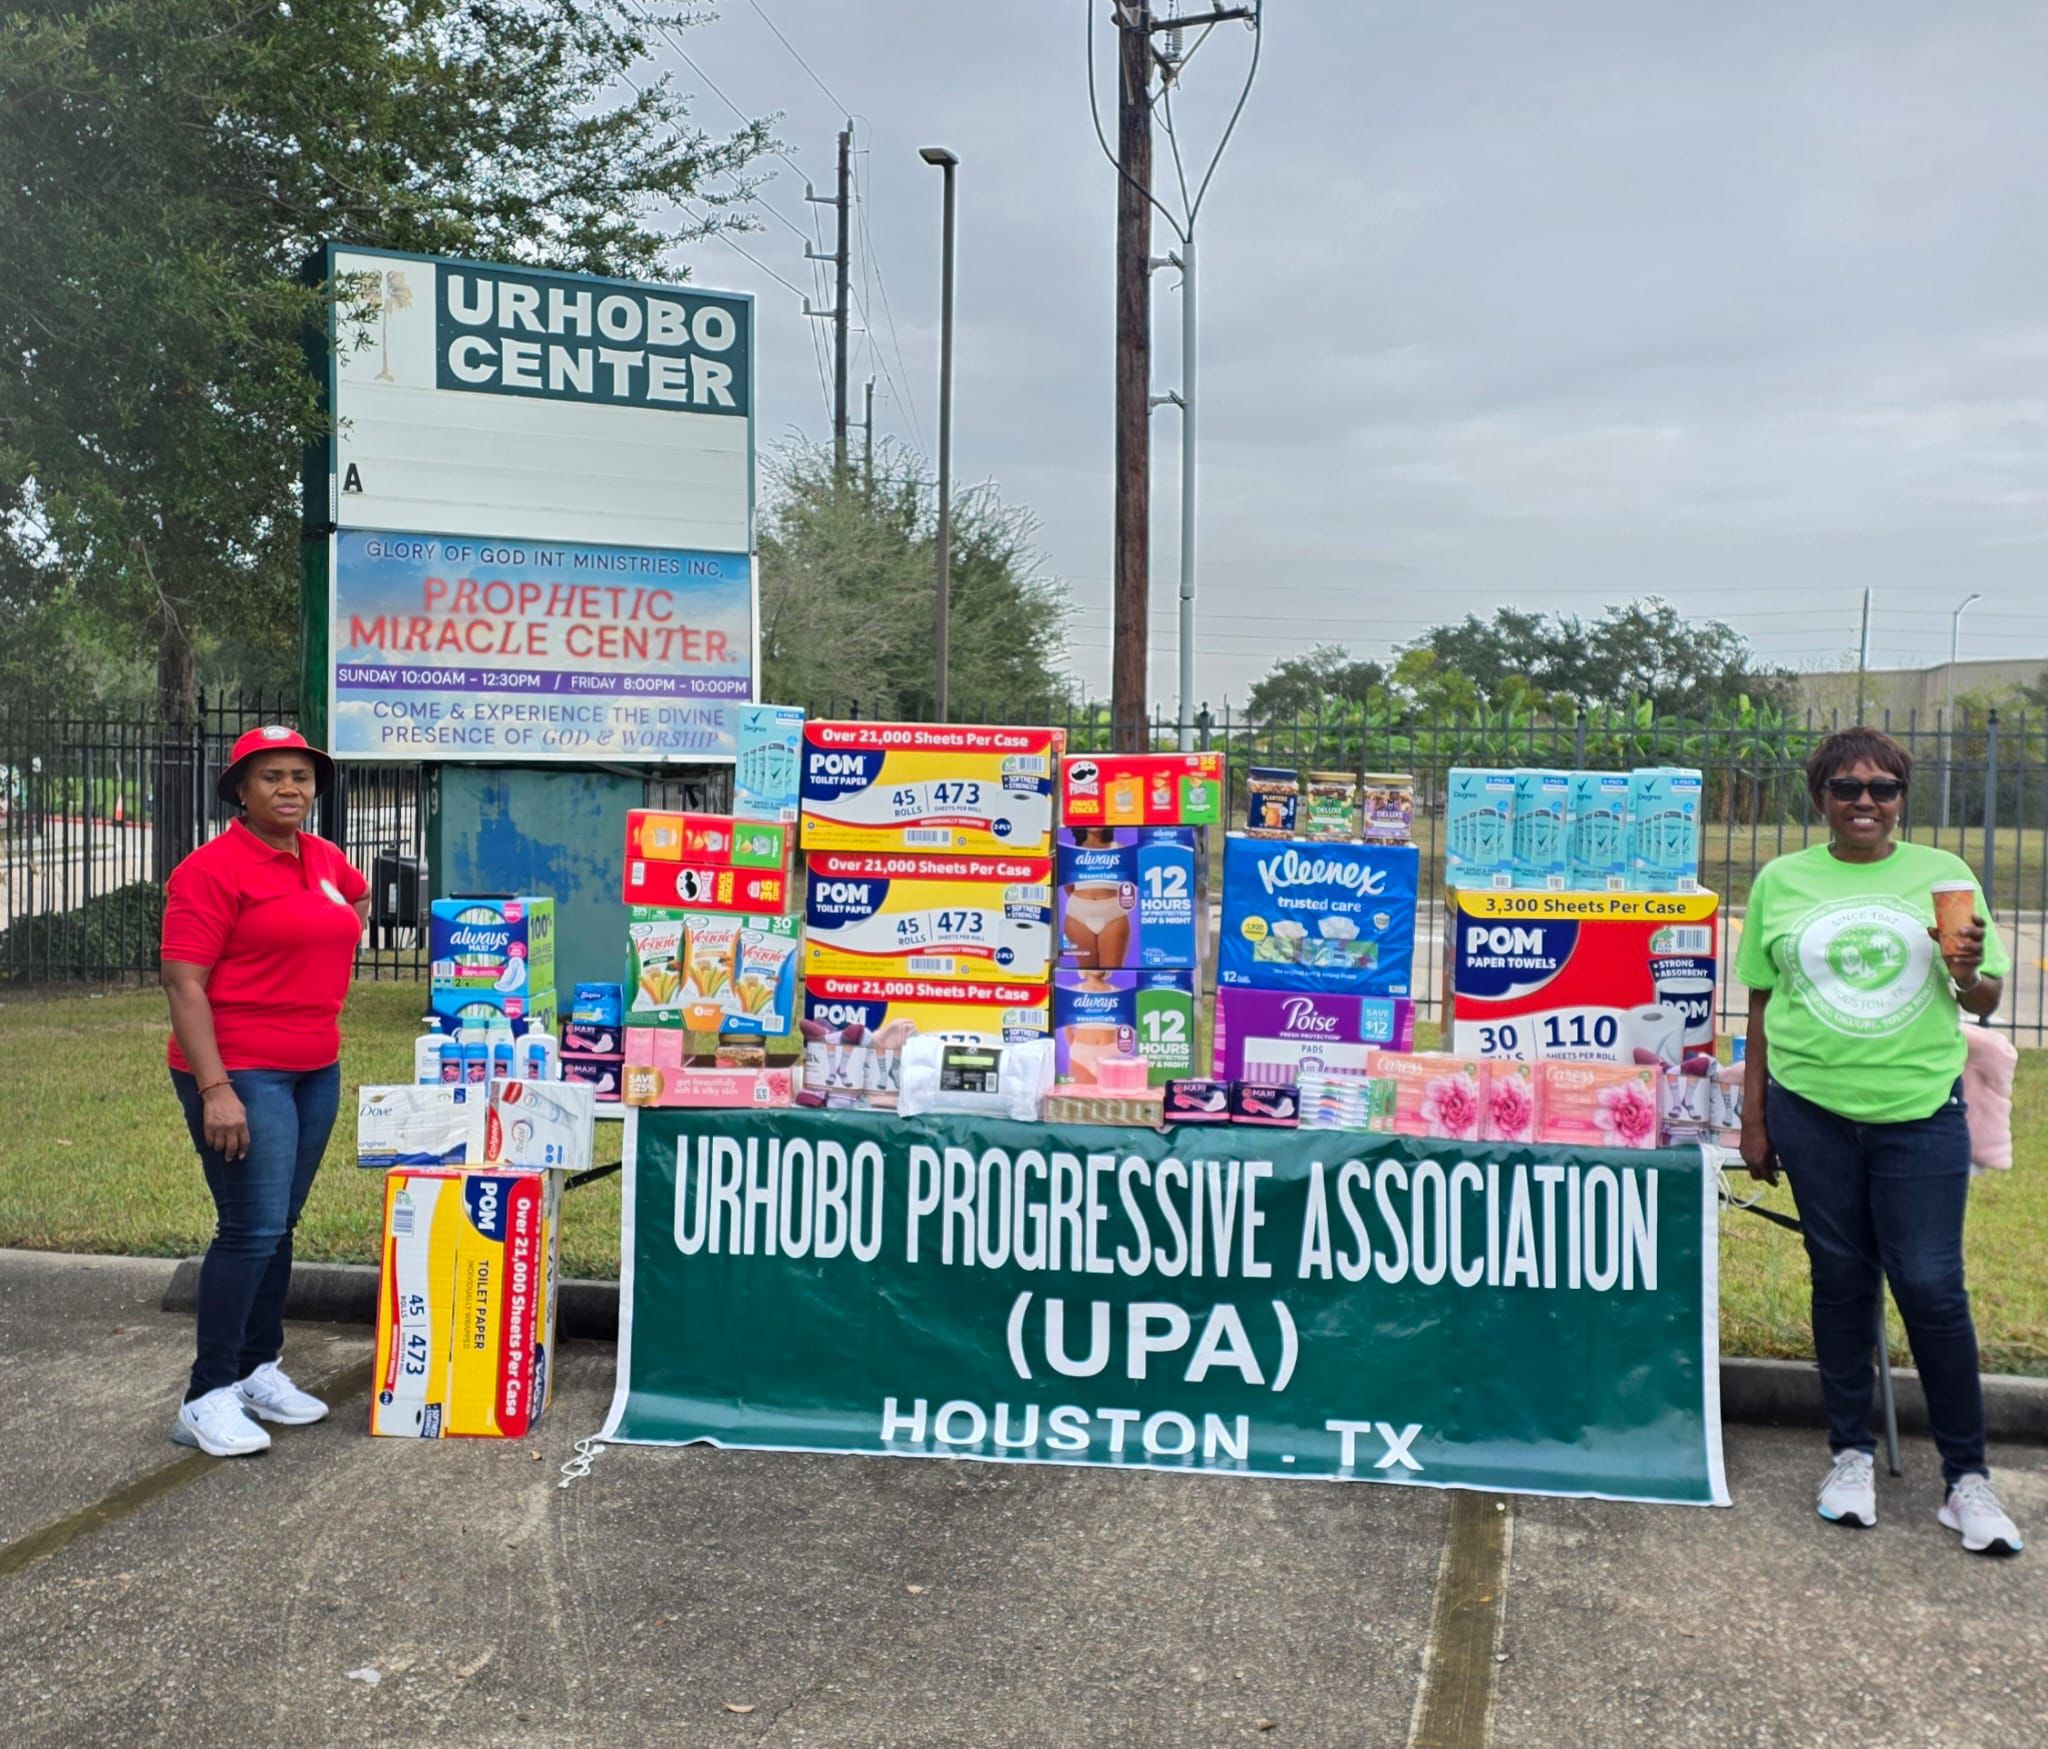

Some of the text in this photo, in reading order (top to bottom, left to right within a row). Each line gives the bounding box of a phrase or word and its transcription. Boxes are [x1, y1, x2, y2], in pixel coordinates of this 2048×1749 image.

[447, 273, 737, 352] URHOBO
[447, 334, 736, 407] CENTER
[342, 462, 364, 493] A
[367, 541, 435, 560] GLORY
[444, 545, 472, 561] OF
[480, 548, 525, 565] GOD
[534, 551, 566, 566] INT
[574, 554, 680, 574] MINISTRIES
[423, 577, 674, 622] PROPHETIC
[350, 613, 548, 656] MIRACLE
[338, 669, 398, 684] SUNDAY
[401, 670, 465, 685] 10:00AM
[482, 673, 541, 687] 12:30PM
[553, 673, 561, 690] /
[571, 676, 616, 690] FRIDAY
[623, 677, 675, 692] 8:00PM
[690, 679, 747, 693] 10:00PM
[373, 700, 725, 726] COME & EXPERIENCE THE DIVINE
[382, 726, 718, 749] PRESENCE OF GOD & WORSHIP
[743, 724, 767, 734] Degree
[822, 728, 1029, 747] Over 21,000 Sheets Per Case
[809, 753, 864, 775] POM
[810, 776, 867, 785] TOILET PAPER
[892, 783, 980, 807] 45 473
[1454, 791, 1477, 799] Degree
[1638, 794, 1662, 802] Degree
[894, 807, 923, 817] ROLLS
[828, 857, 1031, 876] Over 21,000 Sheets Per Case
[1075, 851, 1120, 869] always
[1144, 865, 1188, 898] 12
[1257, 850, 1387, 897] Kleenex
[816, 883, 868, 904] POM
[816, 904, 872, 914] TOILET PAPER
[1141, 899, 1191, 910] HOURS
[1277, 897, 1362, 912] trusted care
[1486, 898, 1687, 915] 3,300 Sheets Per Case
[772, 917, 792, 929] 30
[896, 911, 983, 935] 45 473
[1141, 917, 1191, 925] DAY NIGHT
[450, 926, 510, 952] always
[635, 937, 679, 952] Veggie
[691, 930, 735, 945] Veggie
[898, 934, 926, 945] ROLLS
[1466, 927, 1543, 955] POM
[742, 943, 787, 962] Veggie
[1467, 957, 1556, 969] PAPER TOWELS
[1660, 960, 1694, 969] STRONG
[1222, 970, 1237, 982] 12
[1661, 969, 1708, 977] ABSORBENT
[825, 979, 1029, 1001] Over 21,000 Sheets Per Case
[1073, 993, 1119, 1012] always
[814, 1004, 867, 1025] POM
[1281, 997, 1338, 1032] Poise
[1367, 1009, 1389, 1017] SAVE
[574, 1025, 596, 1034] MAXI
[1142, 1010, 1186, 1042] 12
[1366, 1021, 1388, 1035] $12
[1479, 1015, 1618, 1053] 30 110
[1139, 1043, 1190, 1055] HOURS
[1301, 1044, 1323, 1054] PADS
[1596, 1053, 1616, 1061] ROLL
[574, 1065, 597, 1074] MAXI
[628, 1073, 656, 1084] SAVE
[676, 1080, 691, 1088] get
[1183, 1084, 1206, 1092] MAXI
[1252, 1090, 1275, 1098] MAXI
[359, 1103, 393, 1117] Dove
[488, 1118, 499, 1158] Colgate
[477, 1181, 498, 1233] POM
[673, 1134, 1659, 1291] URHOBO PROGRESSIVE ASSOCIATION
[462, 1260, 474, 1349] INDIVIDUALLY WRAPPED
[473, 1260, 490, 1350] TOILET PAPER
[505, 1197, 531, 1417] Over 21,000 Sheets Per Case
[405, 1294, 427, 1375] 45 473
[1006, 1291, 1299, 1392] (UPA)
[880, 1397, 1249, 1460] HOUSTON
[1325, 1419, 1425, 1472] TX
